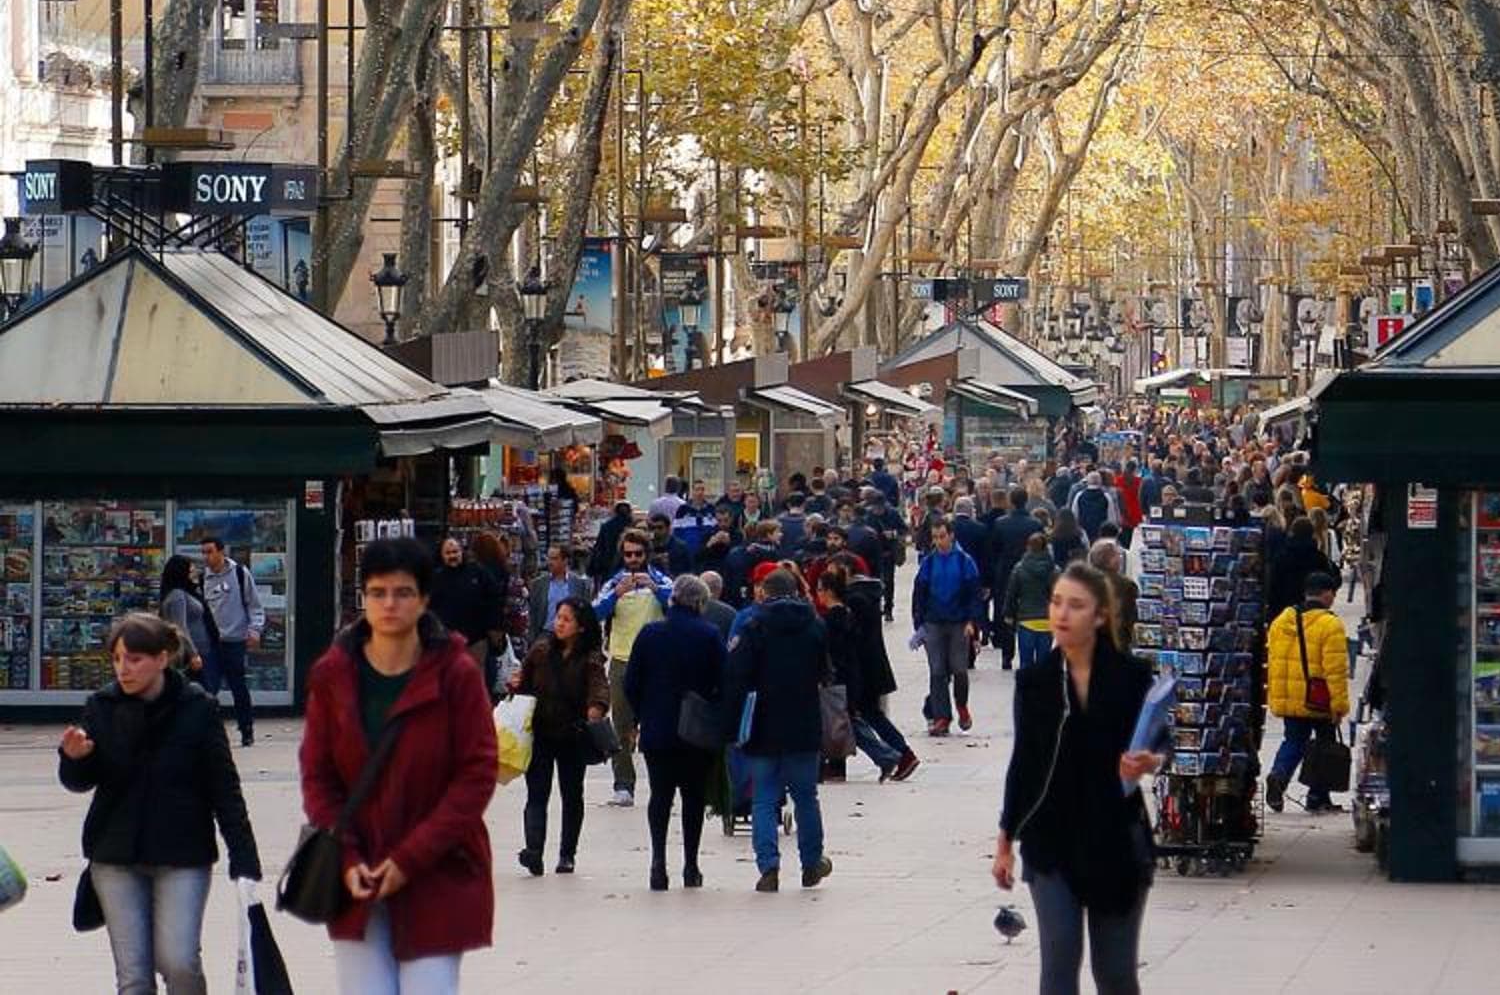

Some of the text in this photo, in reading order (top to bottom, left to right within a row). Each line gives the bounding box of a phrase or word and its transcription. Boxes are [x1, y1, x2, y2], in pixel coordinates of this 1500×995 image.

[25, 171, 58, 201] SONY
[195, 173, 267, 203] SONY
[993, 284, 1019, 298] SONY
